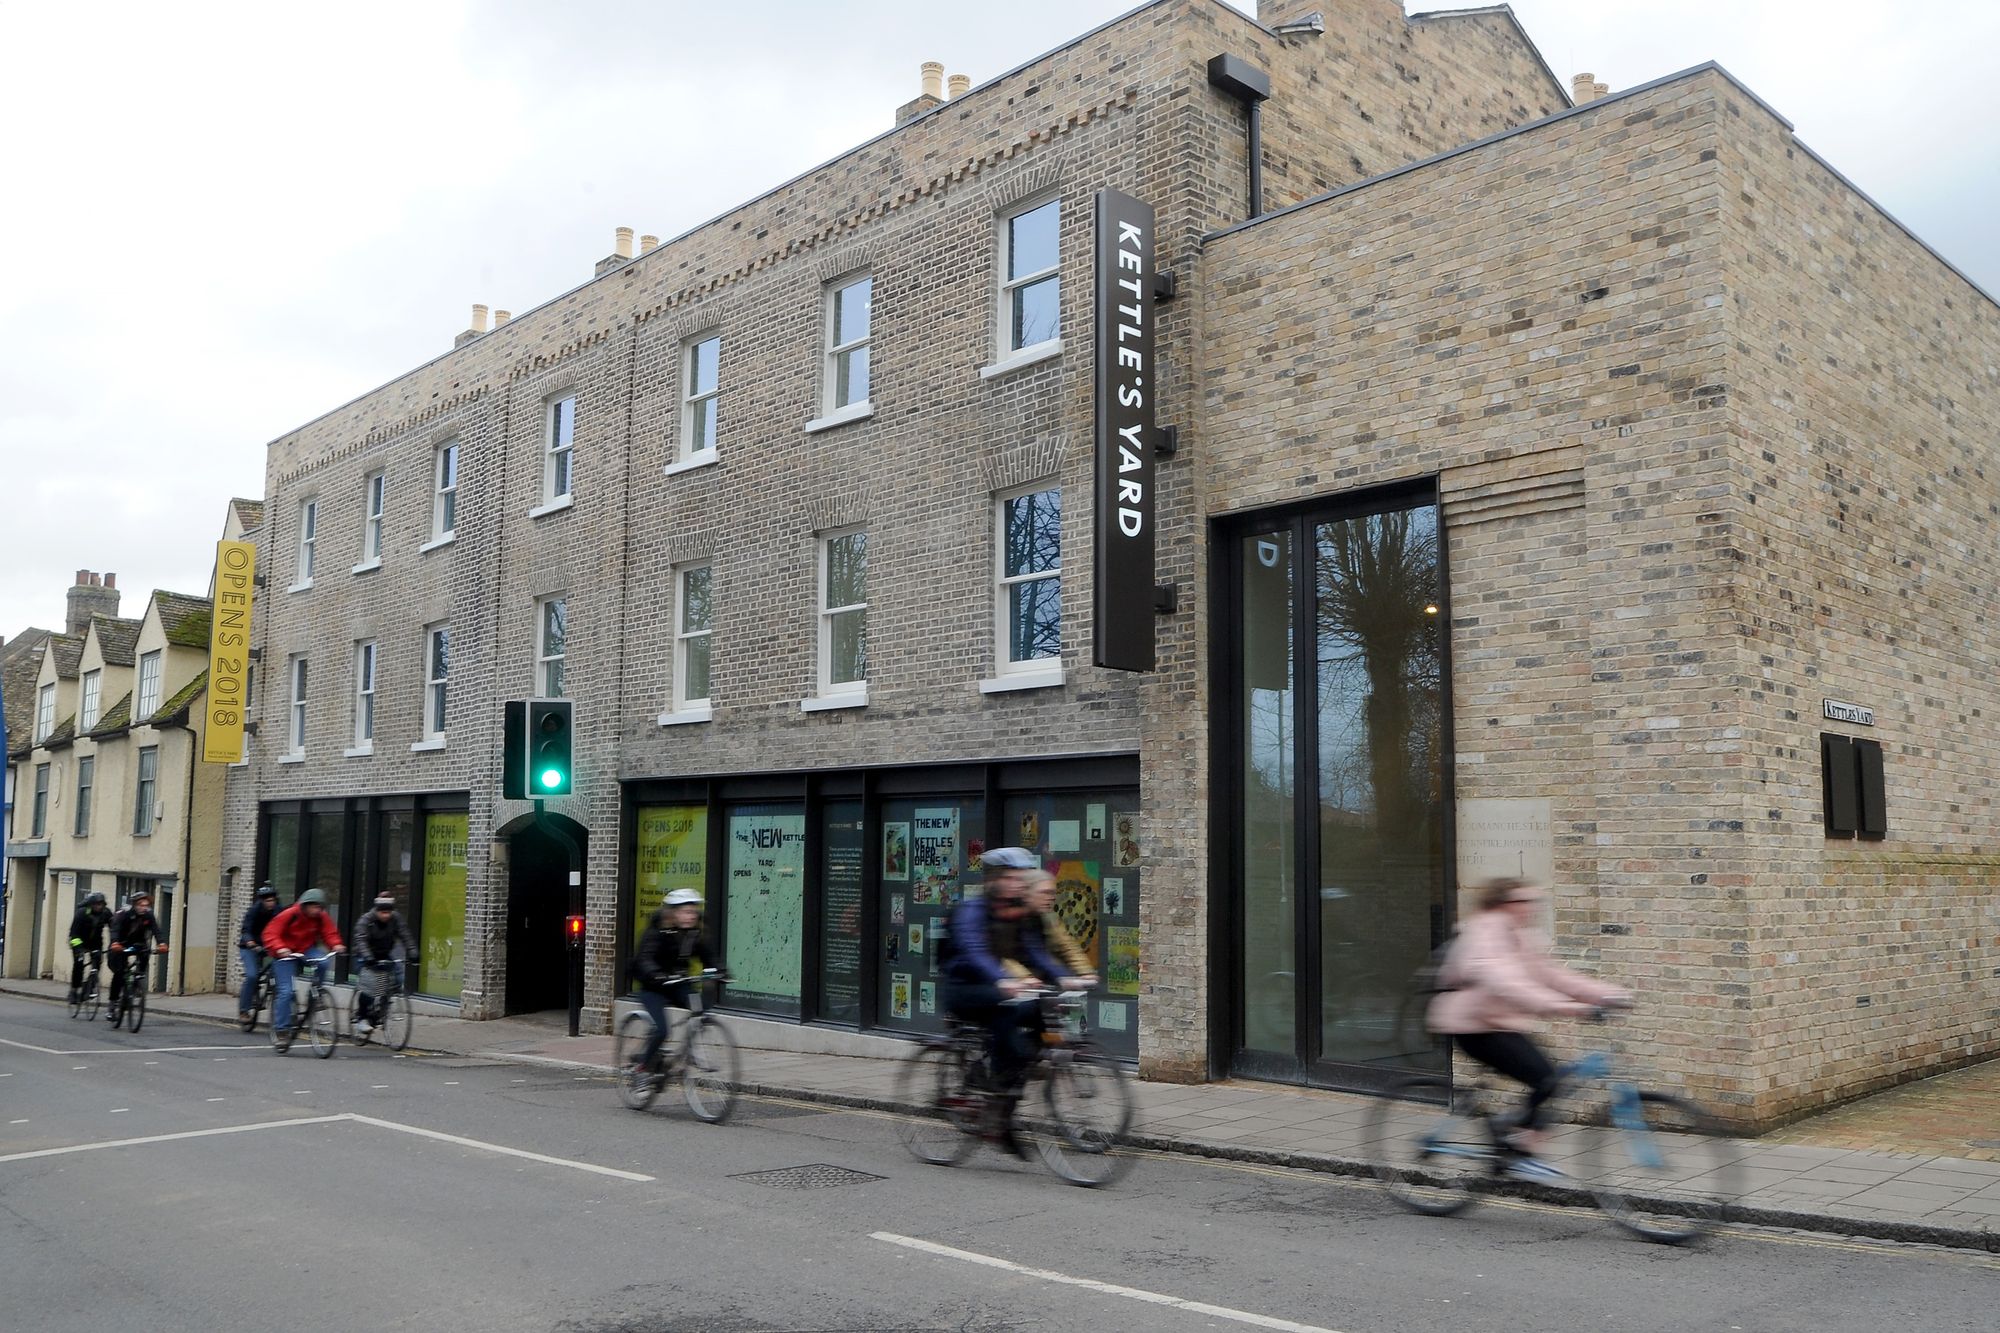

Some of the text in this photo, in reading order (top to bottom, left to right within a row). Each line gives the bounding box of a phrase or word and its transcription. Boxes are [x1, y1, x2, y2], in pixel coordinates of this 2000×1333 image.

[1118, 220, 1143, 537] KETTLE'S YARD
[219, 548, 248, 646] OPENS
[213, 658, 241, 726] 2018
[642, 819, 694, 833] OPENS 2018
[915, 818, 951, 828] THE NEW
[429, 824, 456, 839] OPENS
[752, 828, 782, 849] NEW
[428, 843, 437, 857] 10
[642, 845, 678, 858] THE NEW
[915, 847, 936, 858] YARD
[427, 861, 446, 875] 2018
[641, 861, 701, 874] KETTLE'S YARD
[914, 856, 941, 866] OPENS
[733, 869, 751, 877] OPENS
